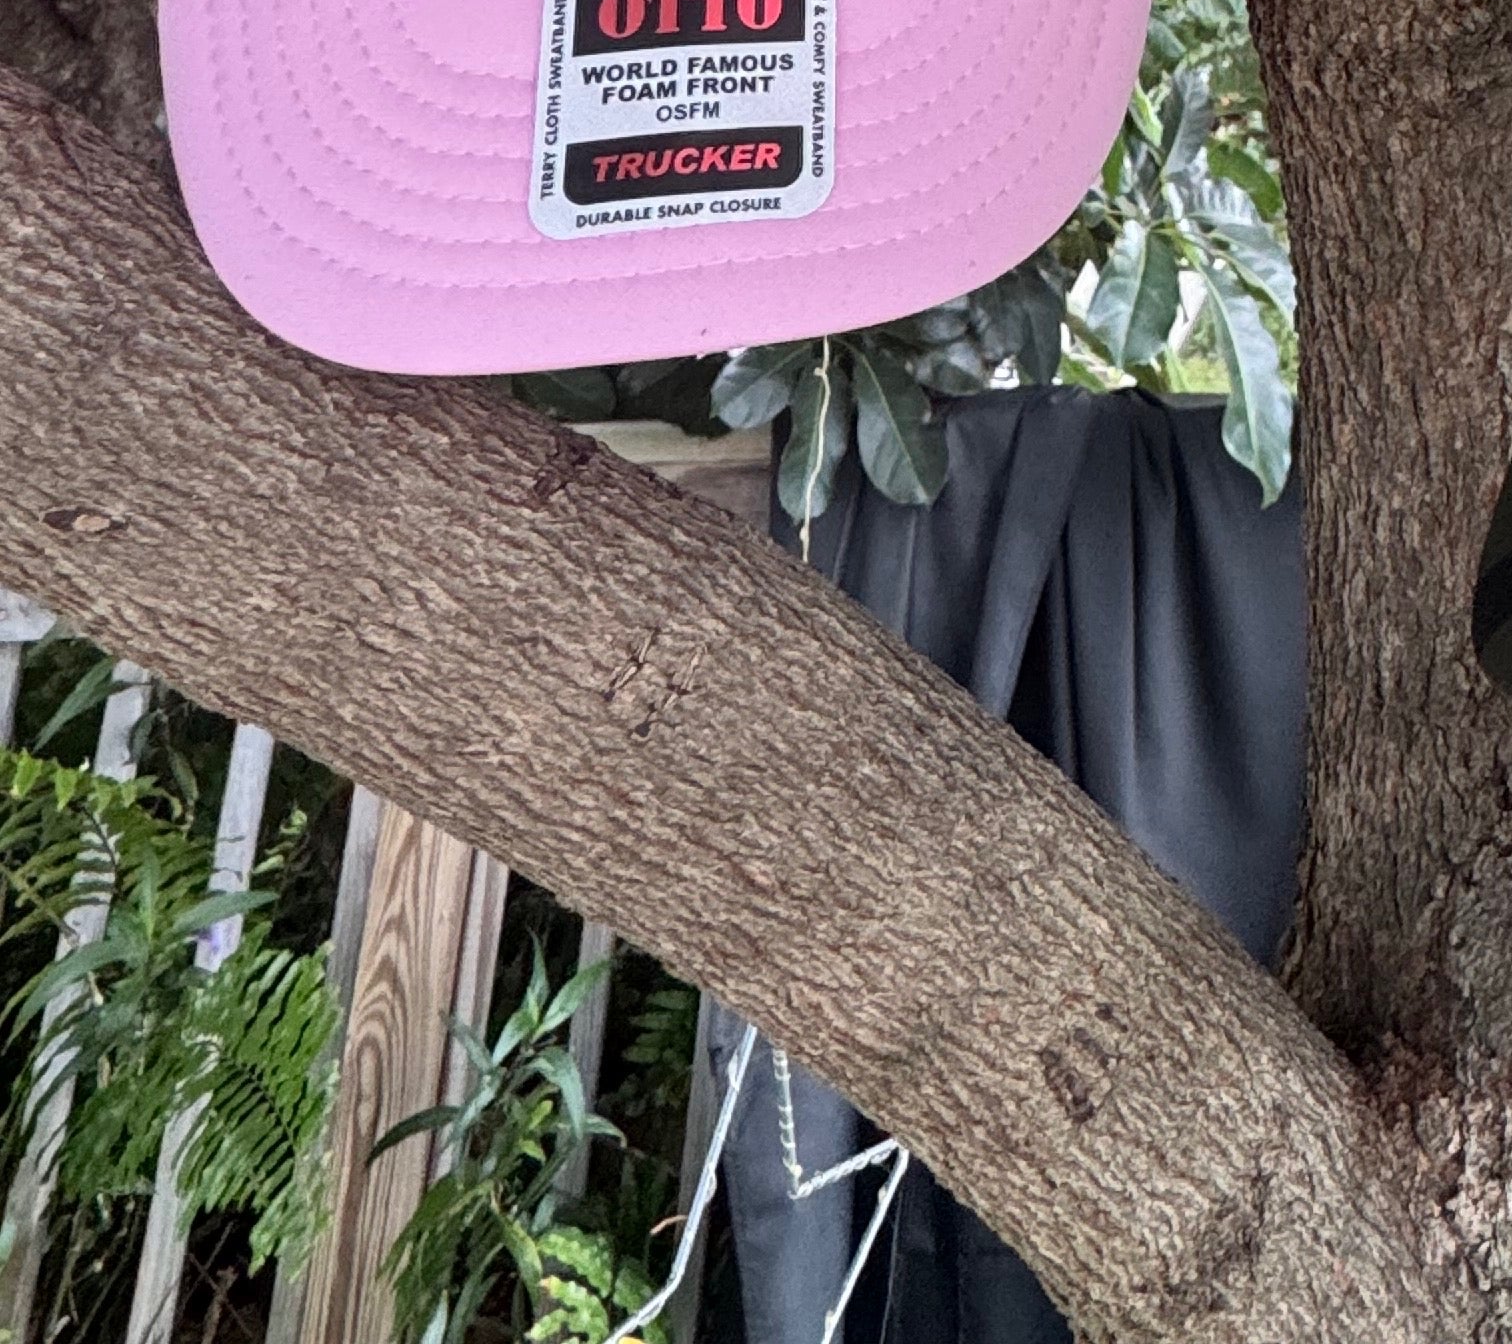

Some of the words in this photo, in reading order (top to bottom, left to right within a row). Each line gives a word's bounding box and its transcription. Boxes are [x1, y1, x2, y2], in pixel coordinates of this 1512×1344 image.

[814, 5, 827, 16] &
[813, 21, 826, 76] COMFY
[581, 59, 678, 85] WORLD
[687, 54, 794, 75] FAMOUS
[602, 80, 676, 104] FOAM
[687, 75, 775, 96] FRONT
[545, 95, 561, 146] CLOTH
[656, 101, 720, 122] OSFM
[812, 81, 825, 178] SWEATBAND
[540, 152, 556, 200] TERRY
[592, 142, 782, 182] TRUCKER
[575, 206, 652, 229] DURABLE
[657, 202, 704, 219] SNAP
[709, 197, 782, 214] CLOSURE
